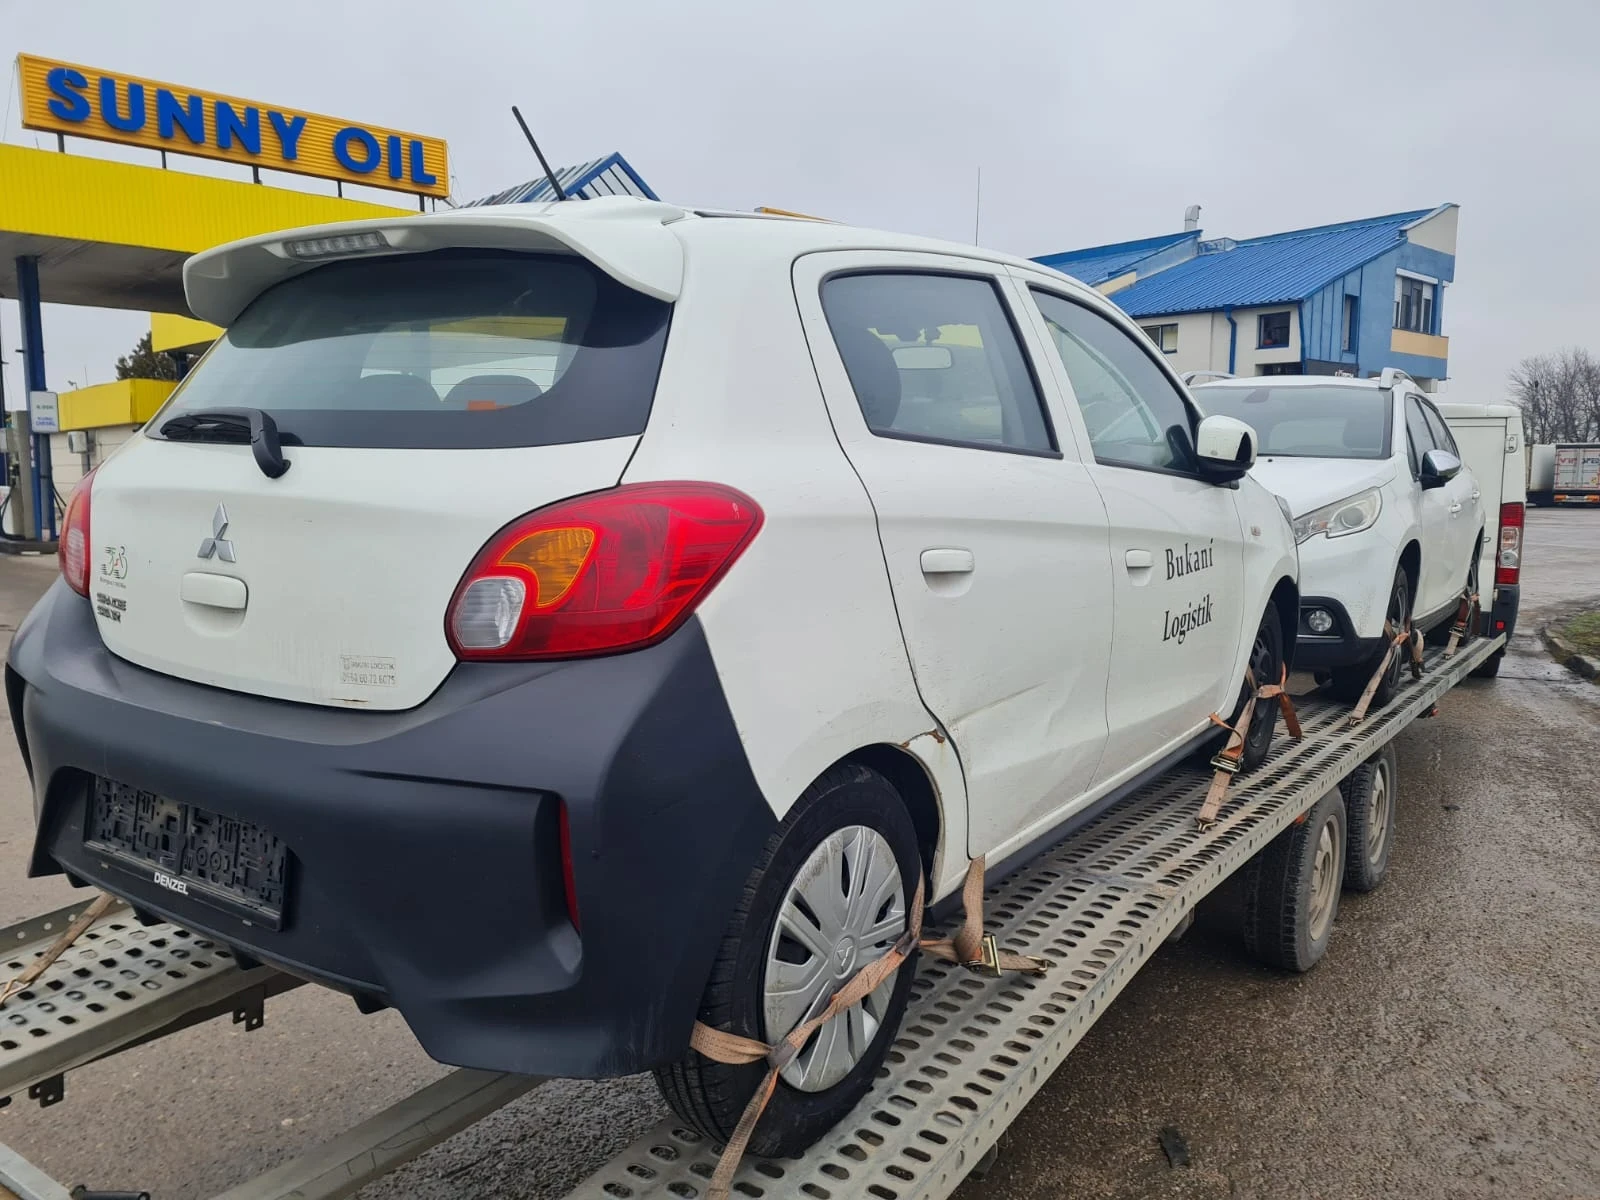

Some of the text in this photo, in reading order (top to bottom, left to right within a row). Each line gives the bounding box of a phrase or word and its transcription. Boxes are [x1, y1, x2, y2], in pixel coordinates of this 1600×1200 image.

[46, 67, 437, 185] SUNNY OIL
[1165, 538, 1214, 580] Bukani
[1162, 593, 1214, 645] Logistik
[154, 871, 189, 895] DENZEL
